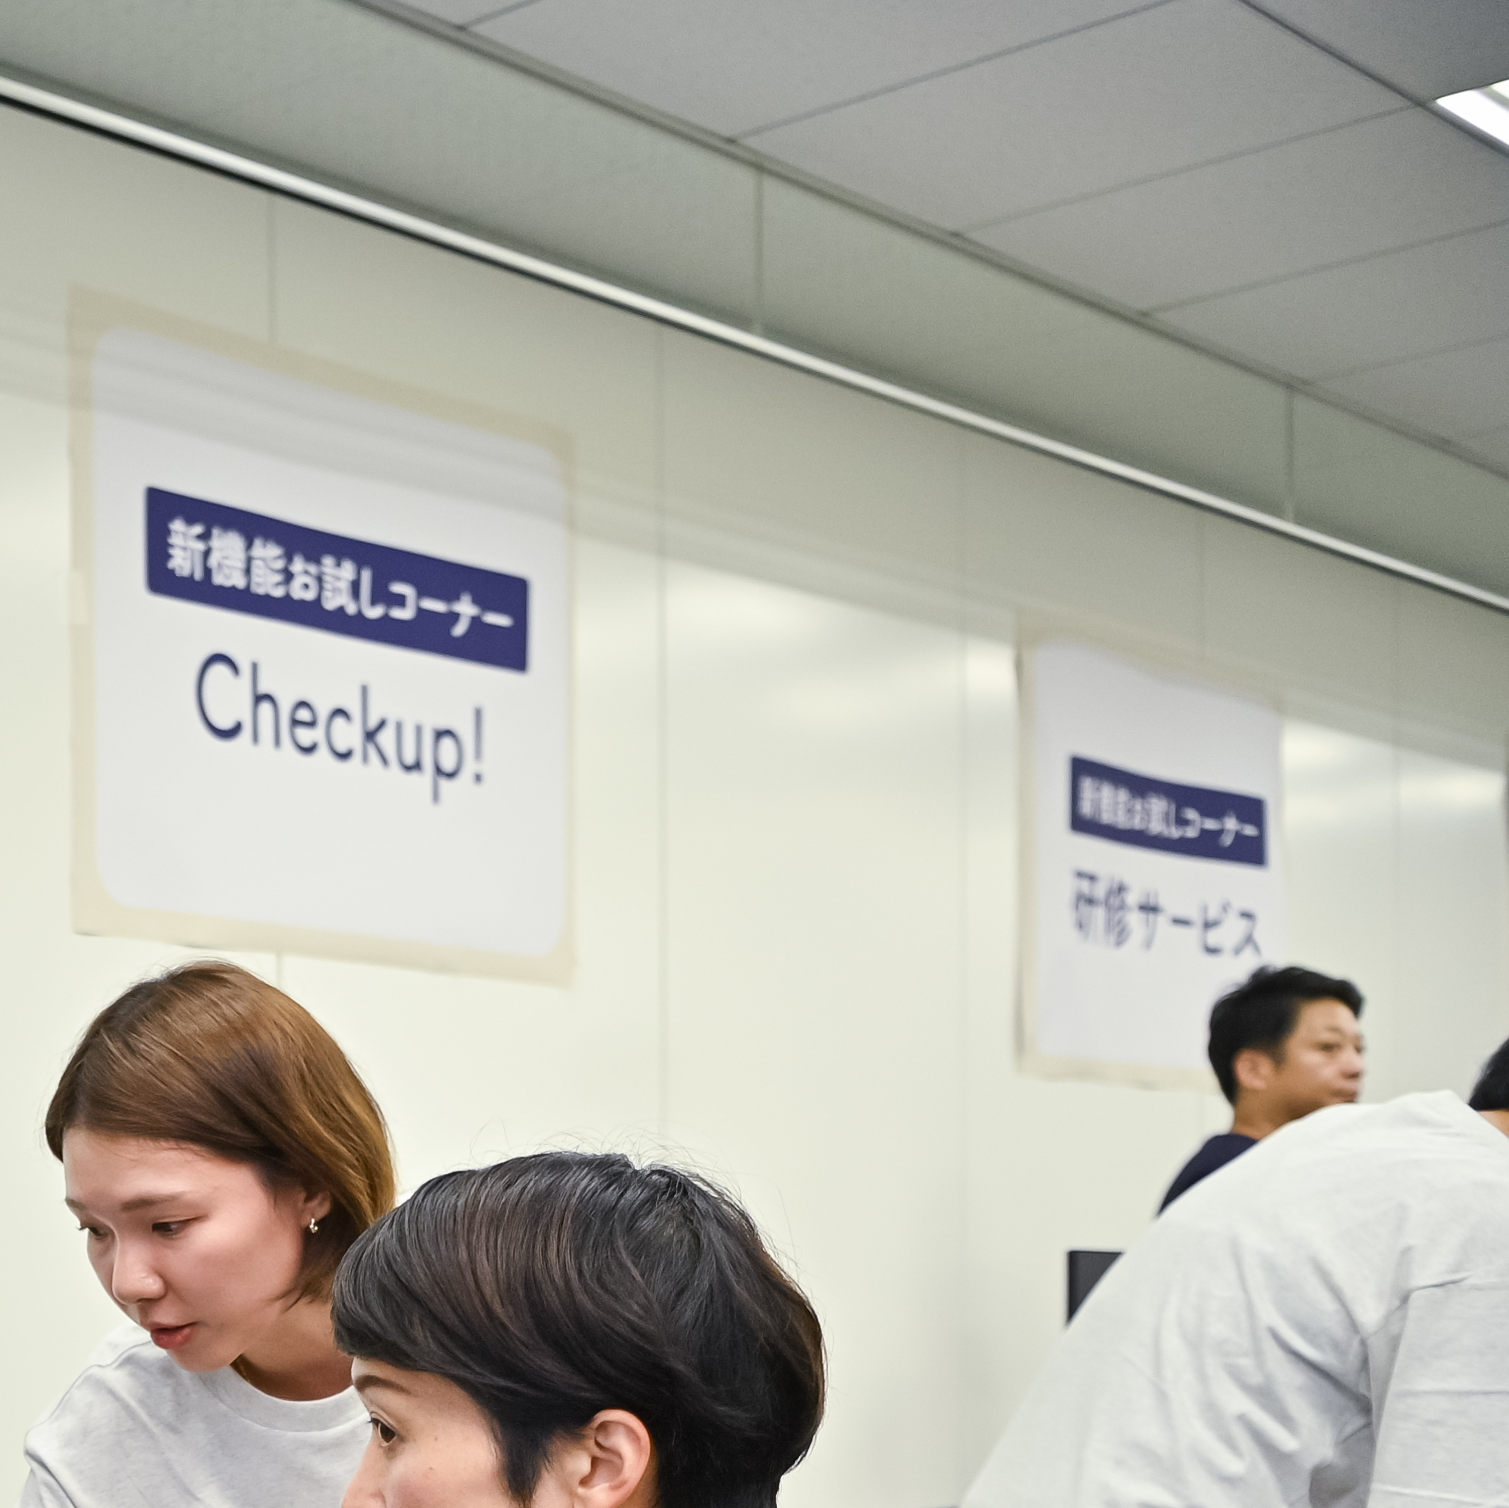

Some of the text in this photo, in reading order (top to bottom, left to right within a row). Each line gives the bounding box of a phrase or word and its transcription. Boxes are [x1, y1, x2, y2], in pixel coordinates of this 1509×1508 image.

[167, 518, 514, 638] 新機能お試しコーナー
[195, 652, 485, 805] Checkup!
[1071, 868, 1263, 958] 研修サービス
